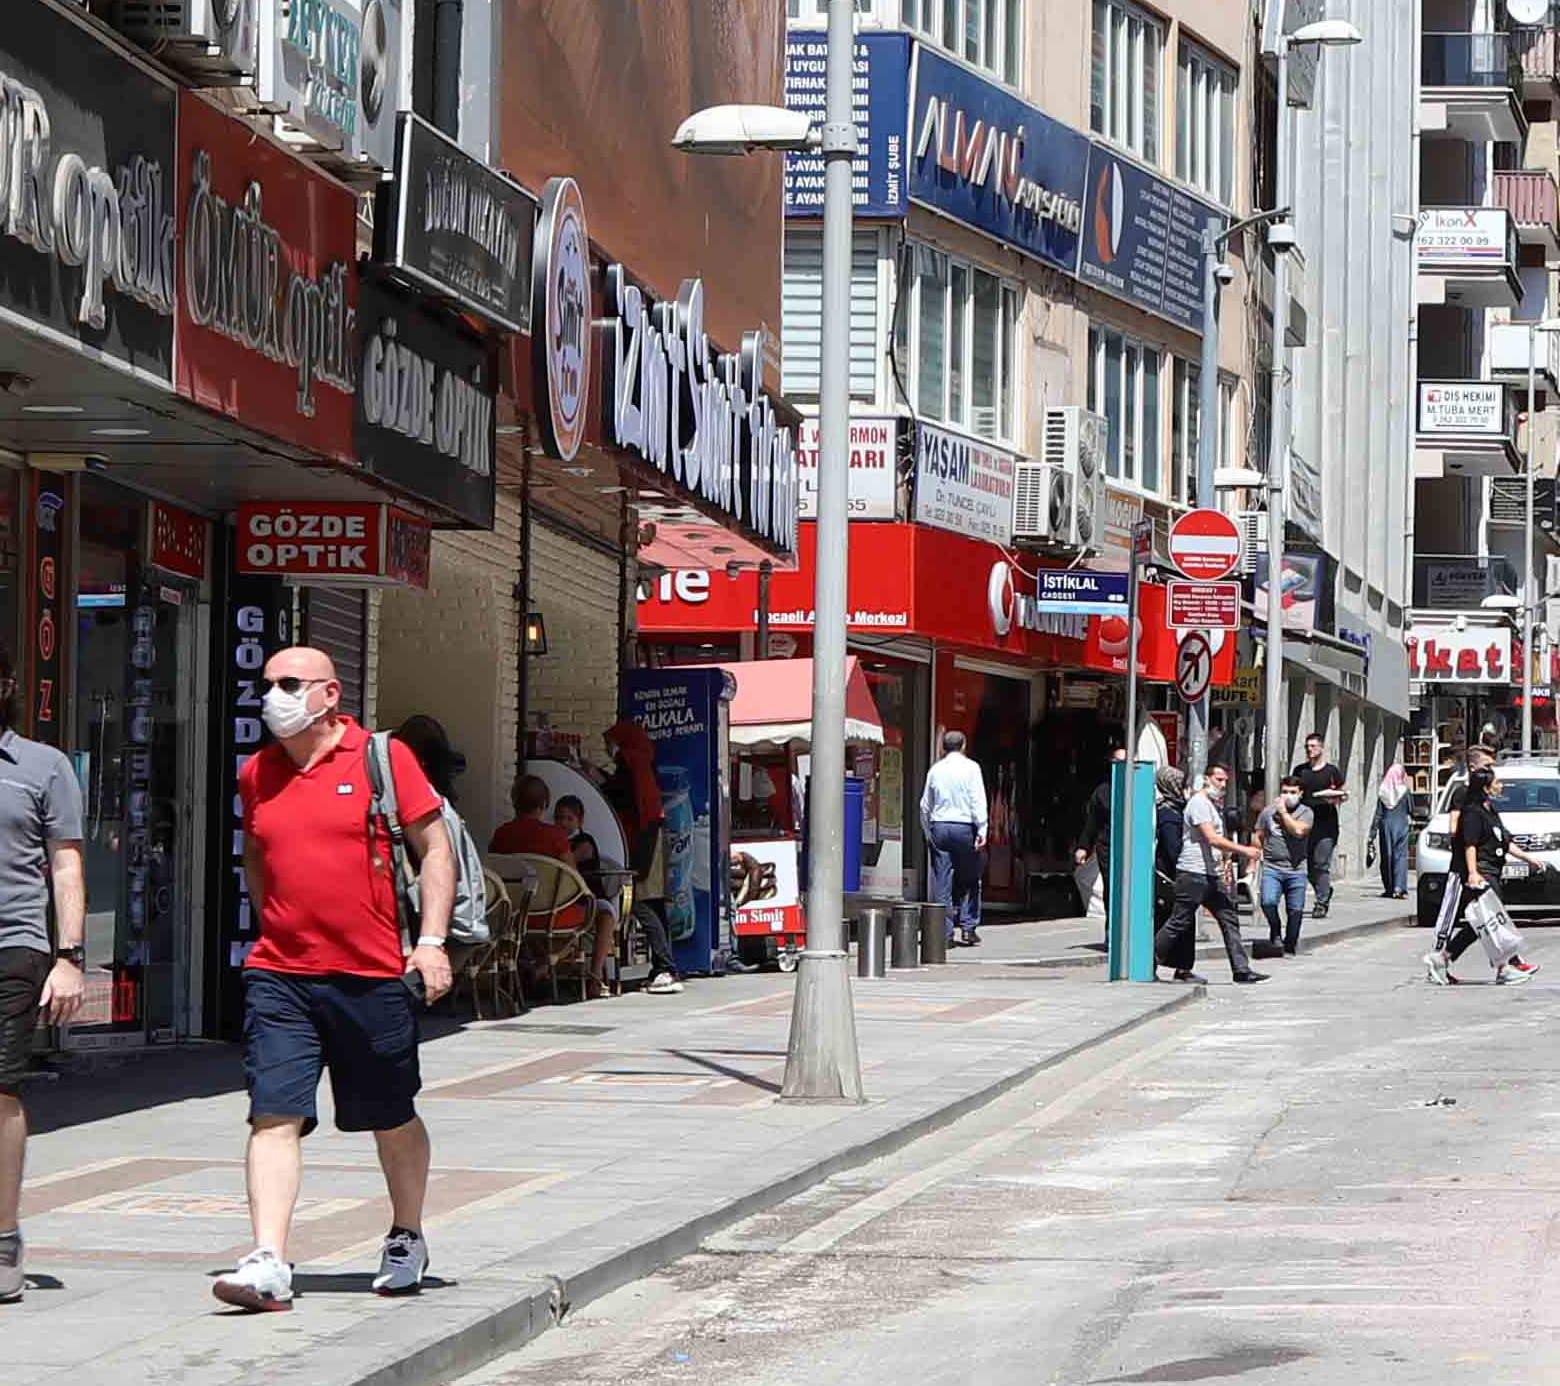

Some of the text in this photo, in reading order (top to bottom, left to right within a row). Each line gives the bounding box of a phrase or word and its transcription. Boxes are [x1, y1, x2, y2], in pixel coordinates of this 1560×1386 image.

[885, 134, 900, 205] İZMİT ŞUBE
[184, 150, 282, 365] ÖMÜR
[361, 316, 493, 478] GÖZDE OPTİK
[850, 427, 888, 444] RMON
[248, 509, 366, 540] GÖZDE
[245, 540, 369, 571] OPTİK
[1043, 573, 1099, 591] İSTİKLAL
[1041, 591, 1076, 600] CADDESİ
[855, 611, 907, 626] Merkezi
[751, 909, 784, 924] Simit
